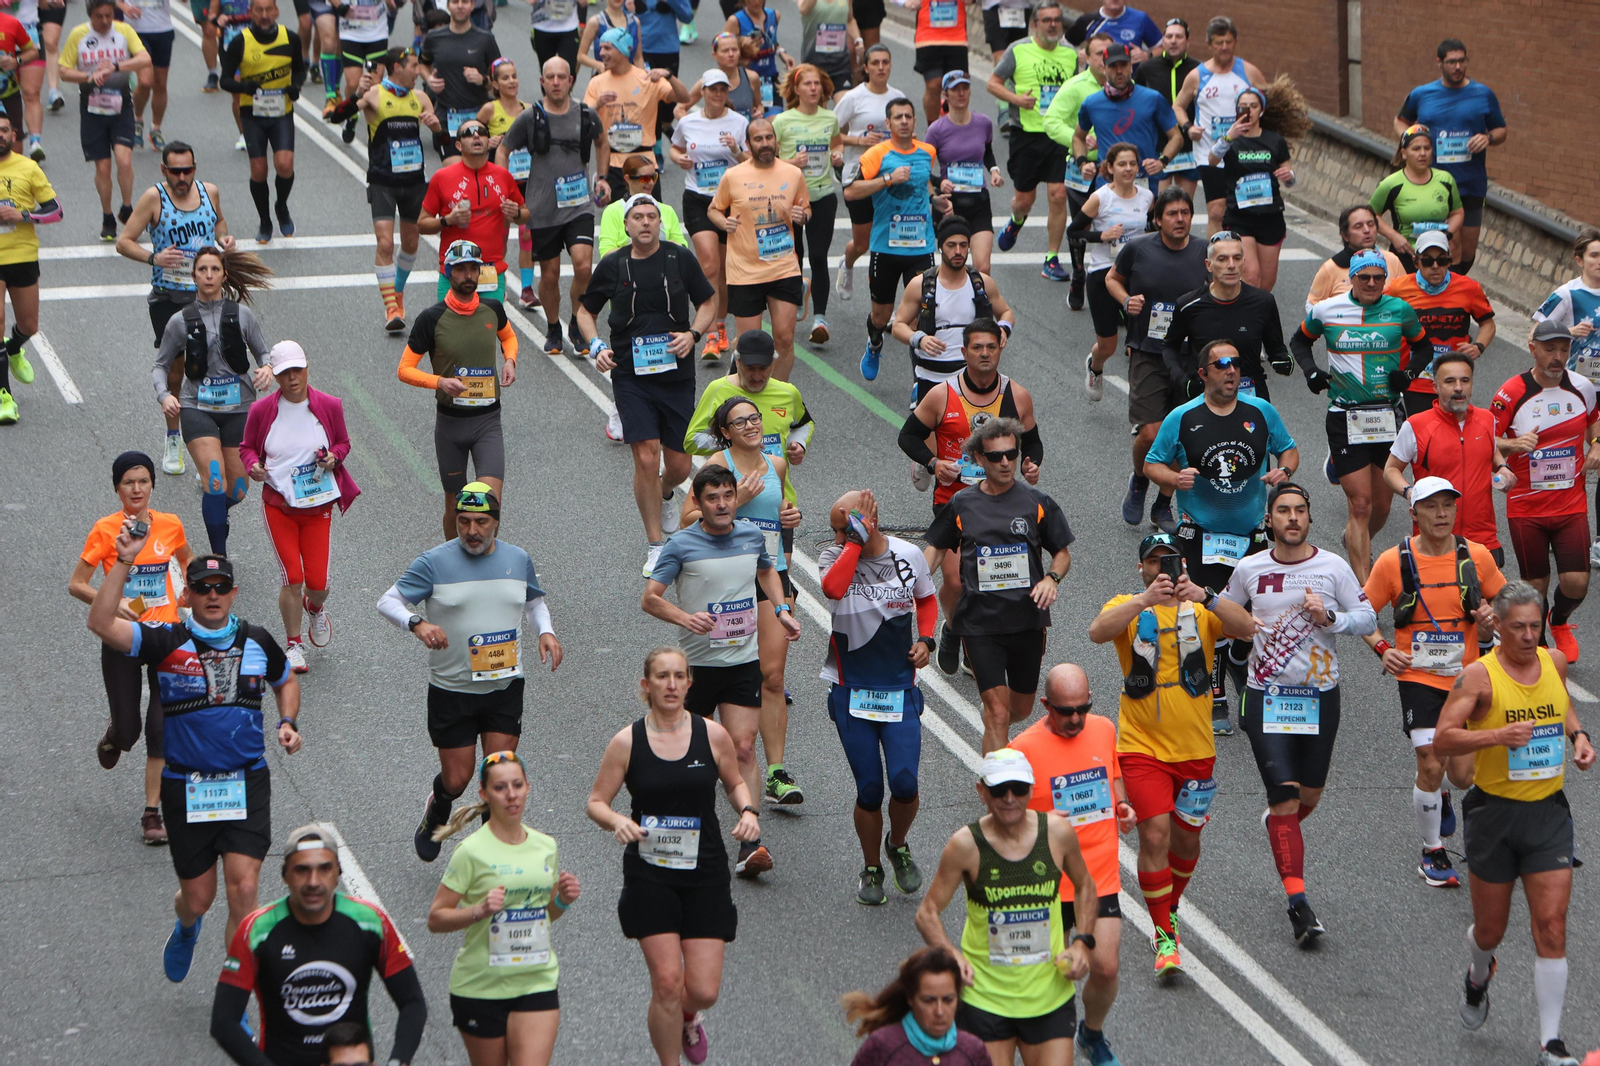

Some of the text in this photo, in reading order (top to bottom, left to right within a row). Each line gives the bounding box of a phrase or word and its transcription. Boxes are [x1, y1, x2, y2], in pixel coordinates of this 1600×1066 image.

[1205, 88, 1219, 99] 22
[401, 141, 418, 149] ZURICH
[1238, 153, 1272, 161] CHICAGO
[704, 160, 725, 168] ZURICH
[566, 174, 584, 182] ZURICH
[1246, 174, 1267, 182] ZURICH
[168, 219, 208, 248] COMO
[769, 226, 787, 235] ZURICH
[645, 335, 669, 343] ZURICH
[1335, 341, 1371, 349] EURAFRICA
[645, 349, 663, 357] 11242
[213, 377, 236, 386] ZURICH
[469, 381, 484, 389] 5873
[212, 389, 228, 397] 11846
[1365, 416, 1381, 424] 8835
[1545, 449, 1571, 457] ZURICH
[1545, 463, 1561, 471] 7691
[753, 520, 777, 530] ZURICH
[1217, 538, 1238, 547] 11485
[994, 545, 1022, 555] ZURICH
[140, 565, 167, 574] ZURICH
[994, 561, 1012, 569] 9496
[989, 572, 1019, 580] SPACEMAN
[138, 579, 158, 588] 11711
[1284, 579, 1324, 588] MARATÓN
[725, 600, 751, 611] ZURICH
[726, 617, 744, 626] 7430
[726, 629, 746, 637] LUISMI
[1430, 634, 1459, 642] ZURICH
[488, 649, 505, 658] 4484
[1429, 648, 1448, 657] 8272
[490, 661, 505, 669] QUINI
[866, 690, 889, 700] 11407
[1283, 687, 1313, 696] ZURICH
[859, 703, 894, 711] ALEJANDRO
[1279, 702, 1303, 711] 12123
[1505, 704, 1562, 724] BRASIL
[1276, 715, 1307, 723] PEPECHIN
[1526, 745, 1551, 756] 11066
[1528, 759, 1550, 768] PAULO
[1070, 769, 1101, 784] ZURICH
[204, 788, 229, 798] 11173
[1070, 788, 1094, 802] 10687
[191, 803, 201, 811] VA
[1072, 803, 1097, 814] JUANJO
[661, 818, 694, 828] ZURICH
[657, 835, 682, 846] 10332
[653, 847, 684, 857] Samantha
[985, 879, 1056, 905] DEPORTEMANIA
[1009, 911, 1044, 922] ZURICH
[509, 929, 532, 939] 10112
[1009, 929, 1032, 940] 9738
[280, 980, 343, 998] Donando
[284, 991, 343, 1011] Vidas
